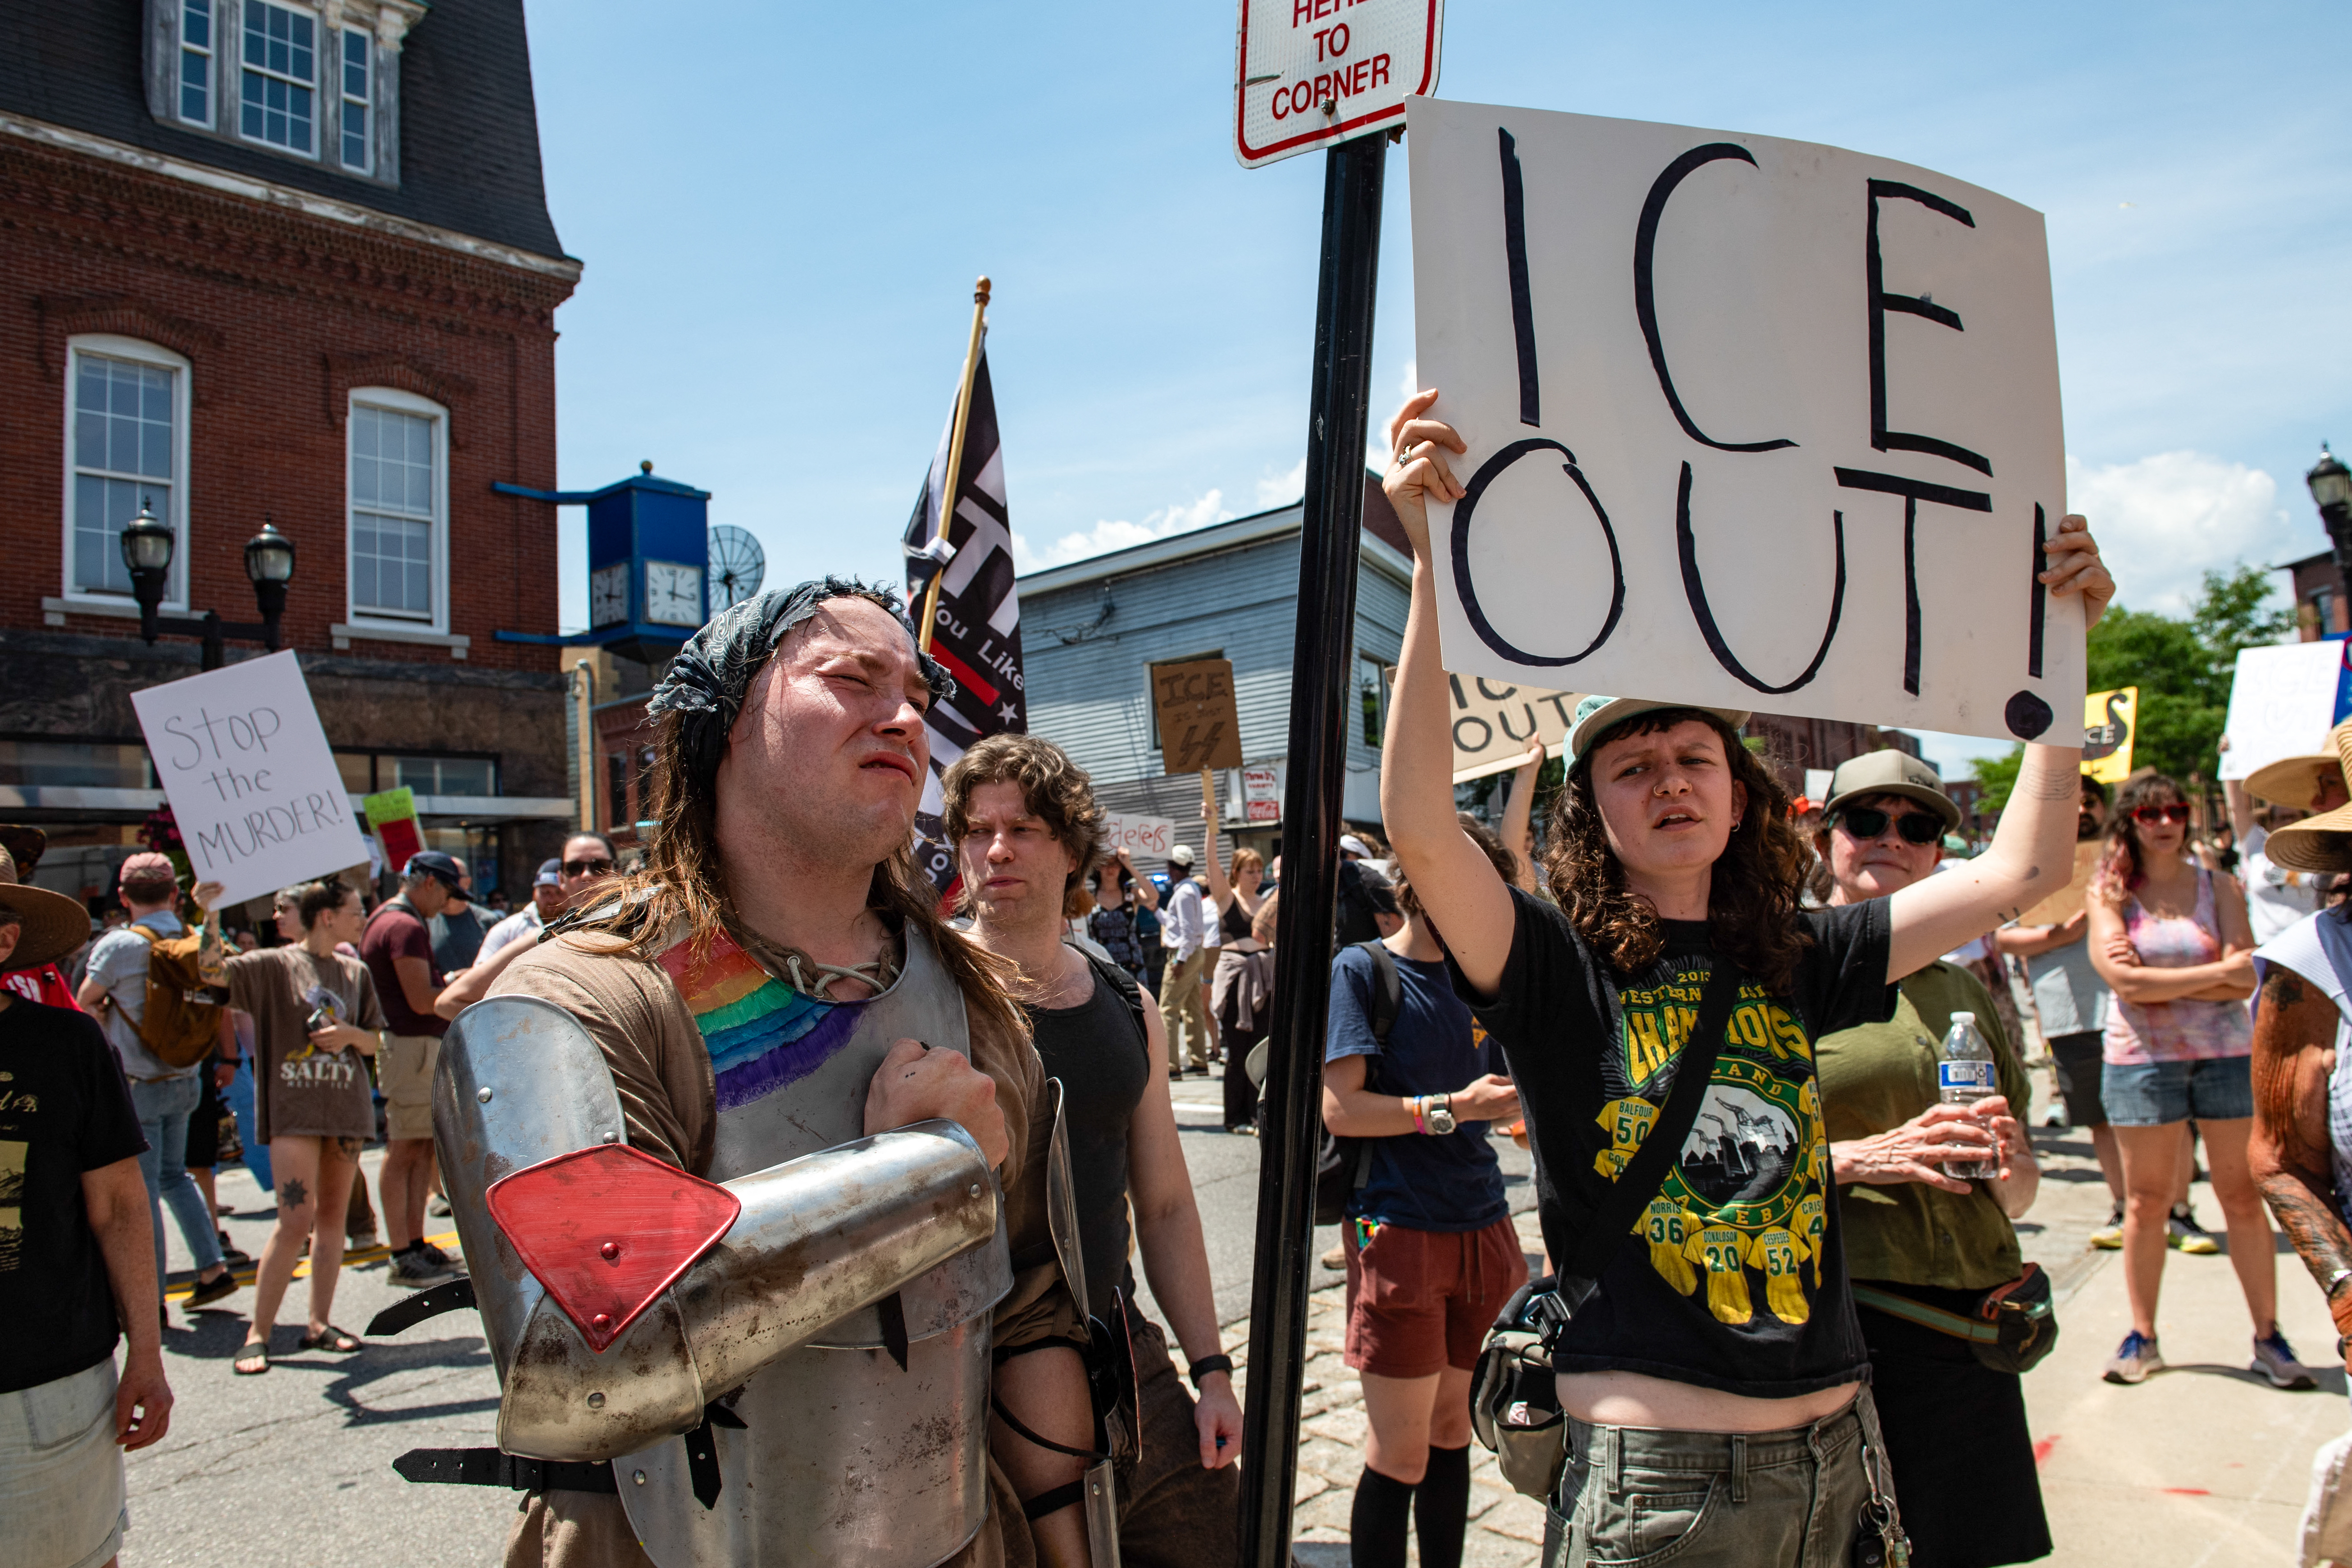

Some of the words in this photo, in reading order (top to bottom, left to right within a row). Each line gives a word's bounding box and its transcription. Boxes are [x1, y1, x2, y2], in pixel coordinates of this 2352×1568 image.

[1293, 0, 1373, 28] HE
[1313, 23, 1349, 62] TO
[1272, 53, 1390, 120] CORNER
[1498, 126, 1993, 478] ICE
[1450, 438, 2054, 741] OUT!
[935, 601, 968, 640] ou
[977, 638, 1024, 691] Like
[1159, 672, 1228, 708] ICE
[1449, 674, 1517, 709] IC
[1453, 692, 1574, 752] OUT
[2084, 723, 2116, 745] CE
[201, 767, 271, 802] the
[197, 789, 344, 869] MURDER!
[1107, 817, 1169, 853] derers
[280, 1061, 355, 1082] SALTY
[1619, 1101, 1653, 1118] BALFOUR
[1616, 1117, 1650, 1145] 50
[1650, 1200, 1682, 1215] NORRIS
[1650, 1217, 1684, 1245] 36
[1703, 1231, 1738, 1243] DONALDSON
[1763, 1232, 1790, 1245] CESPEDES
[1705, 1245, 1740, 1273] 20
[1766, 1247, 1798, 1277] 52
